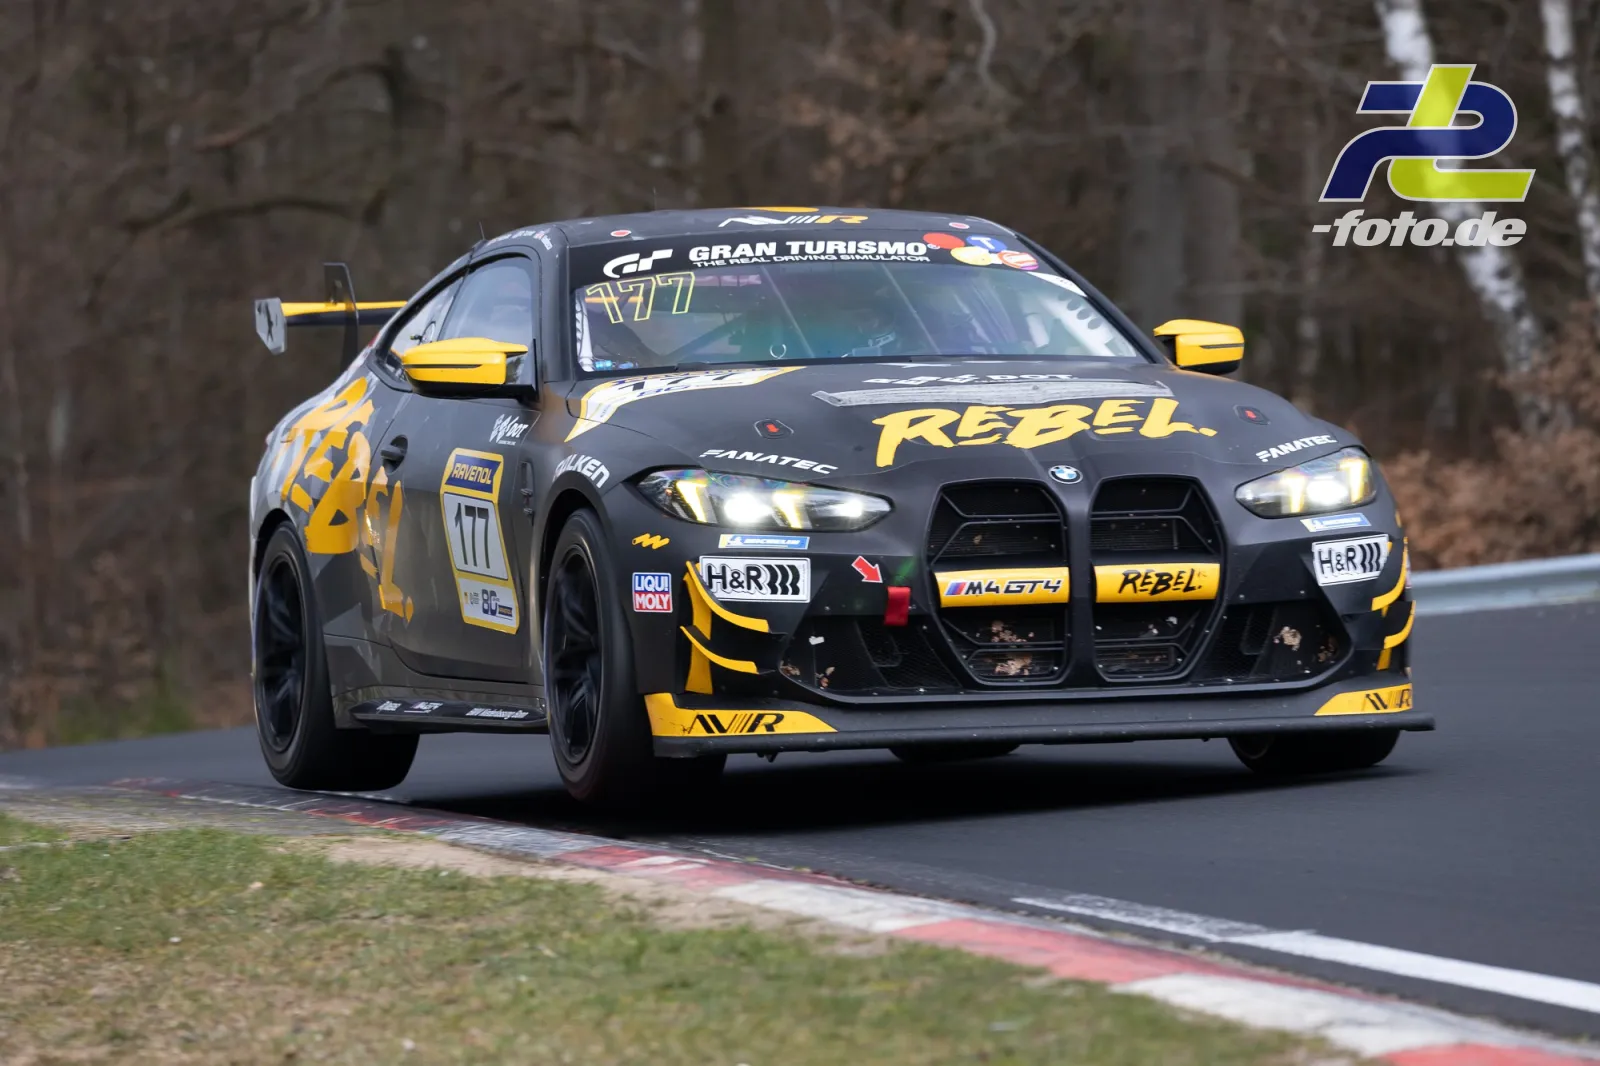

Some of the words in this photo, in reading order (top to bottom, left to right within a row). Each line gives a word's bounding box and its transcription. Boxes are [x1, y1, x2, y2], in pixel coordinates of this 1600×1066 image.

[688, 242, 777, 262] GRAN
[786, 240, 927, 257] TURISMO
[692, 260, 727, 269] THE
[729, 257, 772, 265] REAL
[774, 254, 833, 263] DRIVING
[840, 254, 931, 263] SIMULATOR
[586, 271, 695, 324] 177
[699, 449, 839, 474] FANATEC
[1256, 435, 1337, 463] FANATEC
[452, 462, 493, 485] RAVENOL
[454, 502, 490, 569] 177
[1319, 546, 1359, 575] H&R
[706, 563, 766, 593] H&R
[635, 593, 671, 610] MOLY
